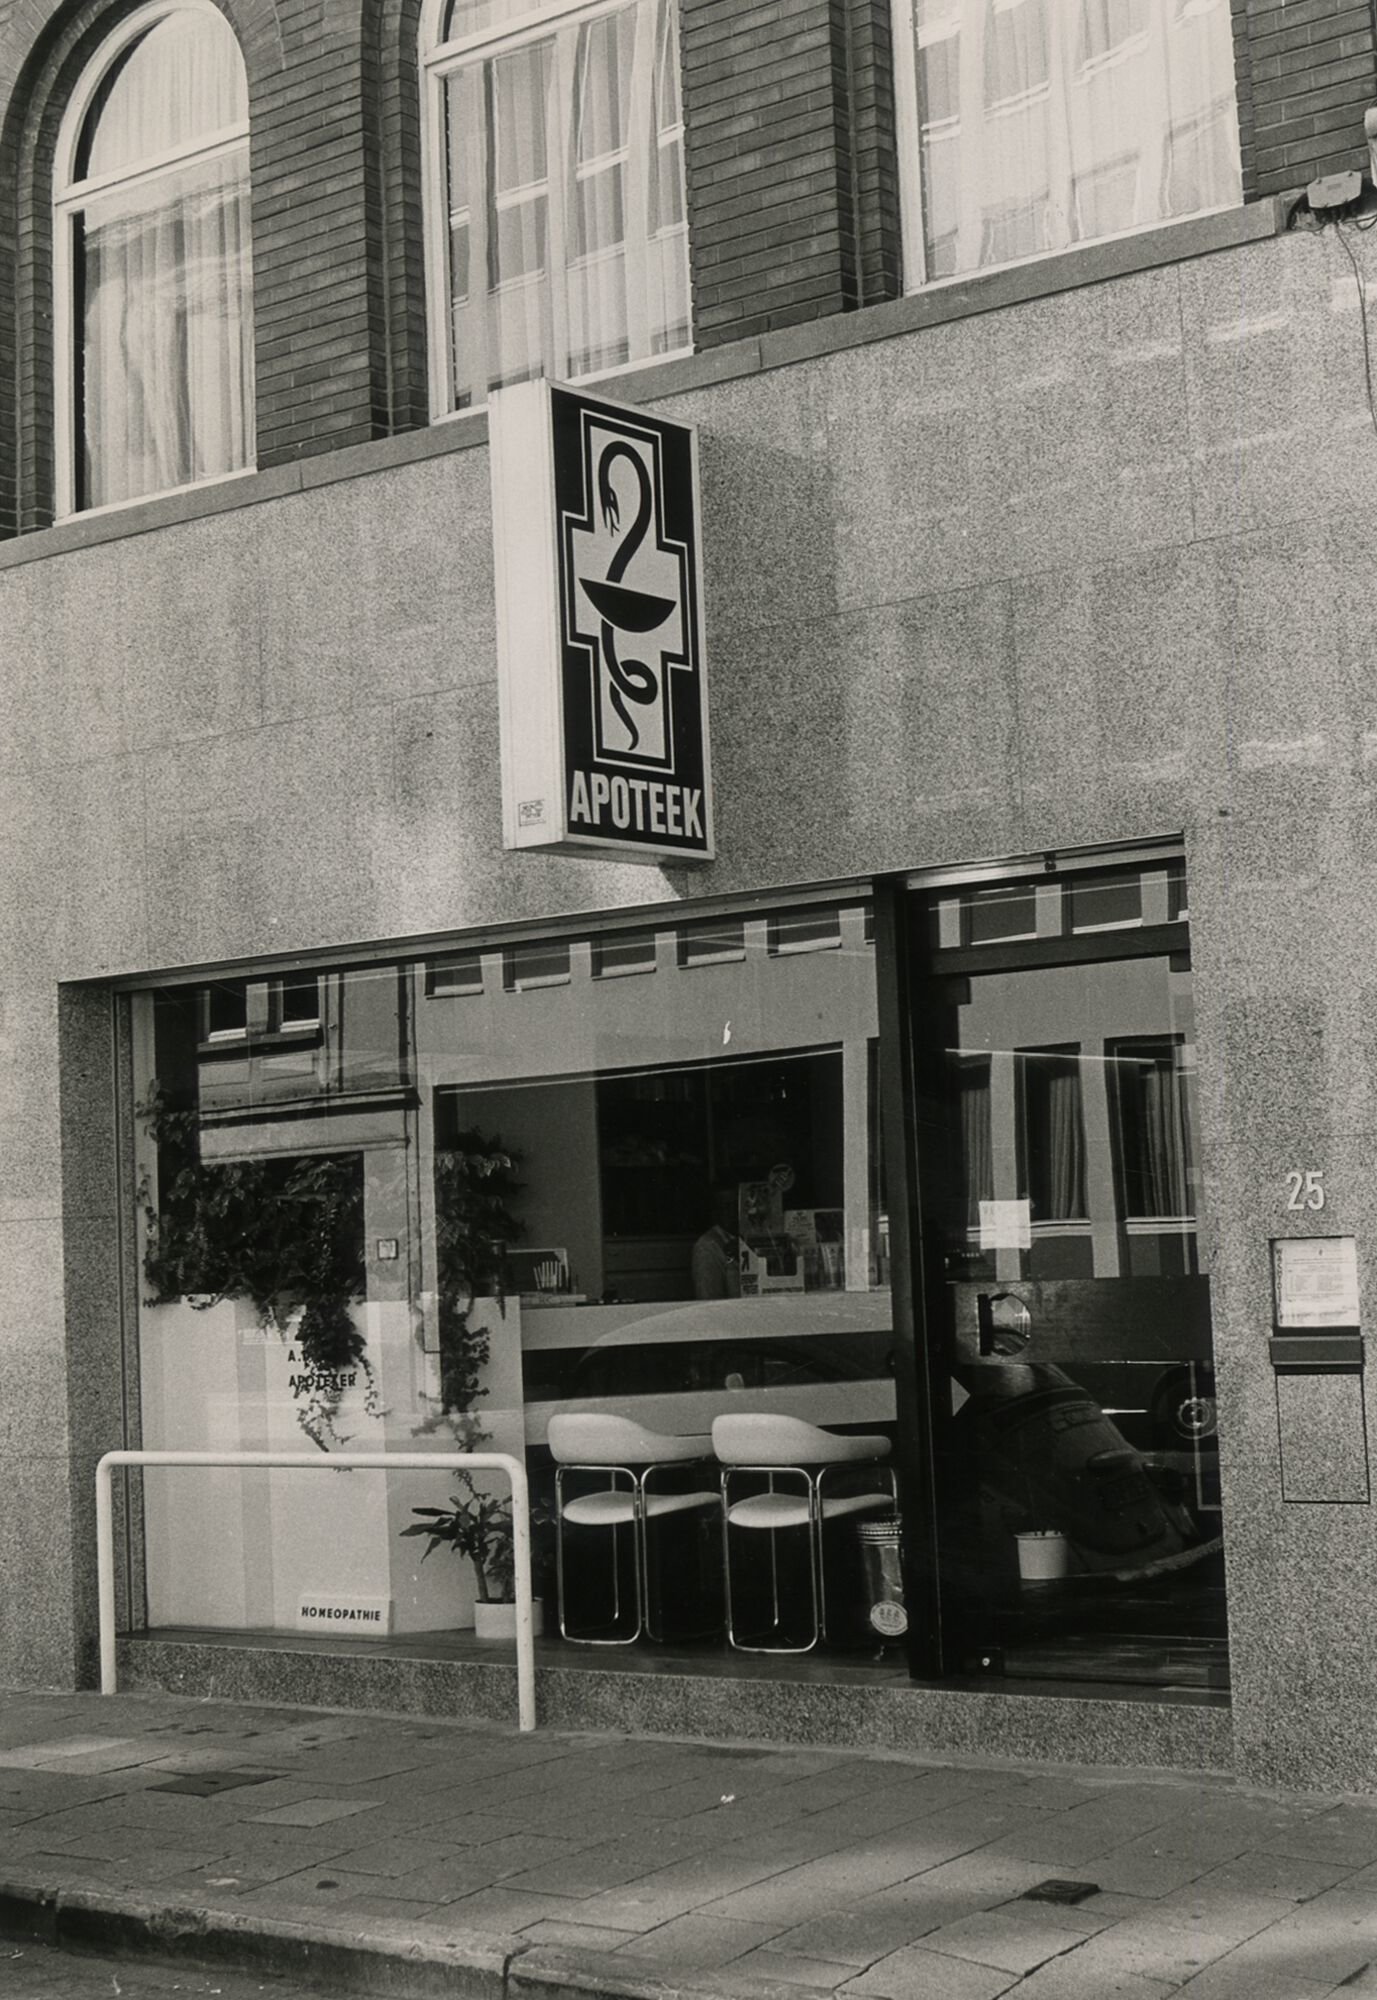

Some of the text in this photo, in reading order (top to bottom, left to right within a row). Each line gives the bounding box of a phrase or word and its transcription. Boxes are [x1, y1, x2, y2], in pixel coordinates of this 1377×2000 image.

[570, 770, 704, 839] APOTEEK
[1285, 1170, 1325, 1211] 25
[301, 1606, 382, 1622] HOMEOPATHIE
